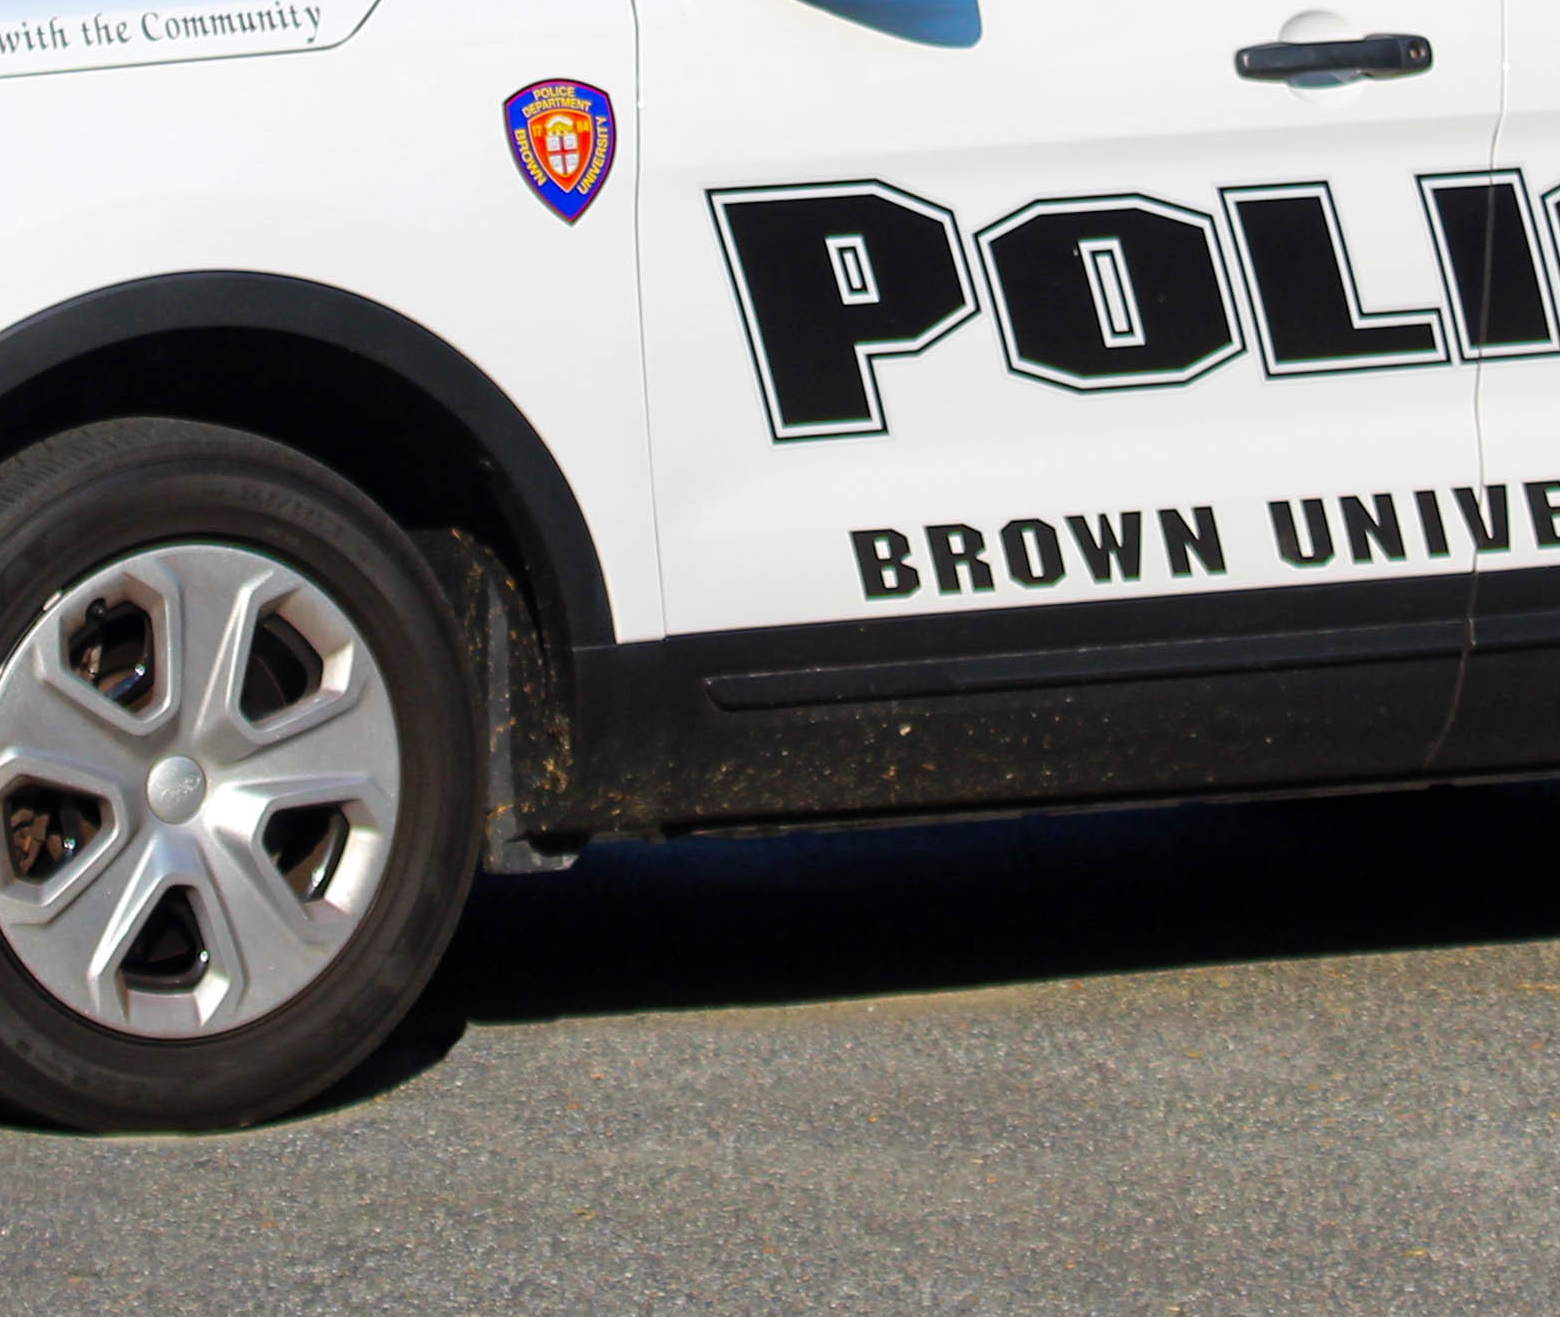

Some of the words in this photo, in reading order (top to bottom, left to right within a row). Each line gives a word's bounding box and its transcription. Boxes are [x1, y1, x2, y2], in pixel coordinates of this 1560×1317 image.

[80, 14, 131, 47] the
[141, 0, 322, 44] Community
[522, 97, 592, 118] DEPARTMENT
[533, 86, 576, 100] POLICE
[515, 129, 547, 186] BROWN
[577, 116, 608, 195] UNIVERSITY
[849, 506, 1228, 601] BROWN
